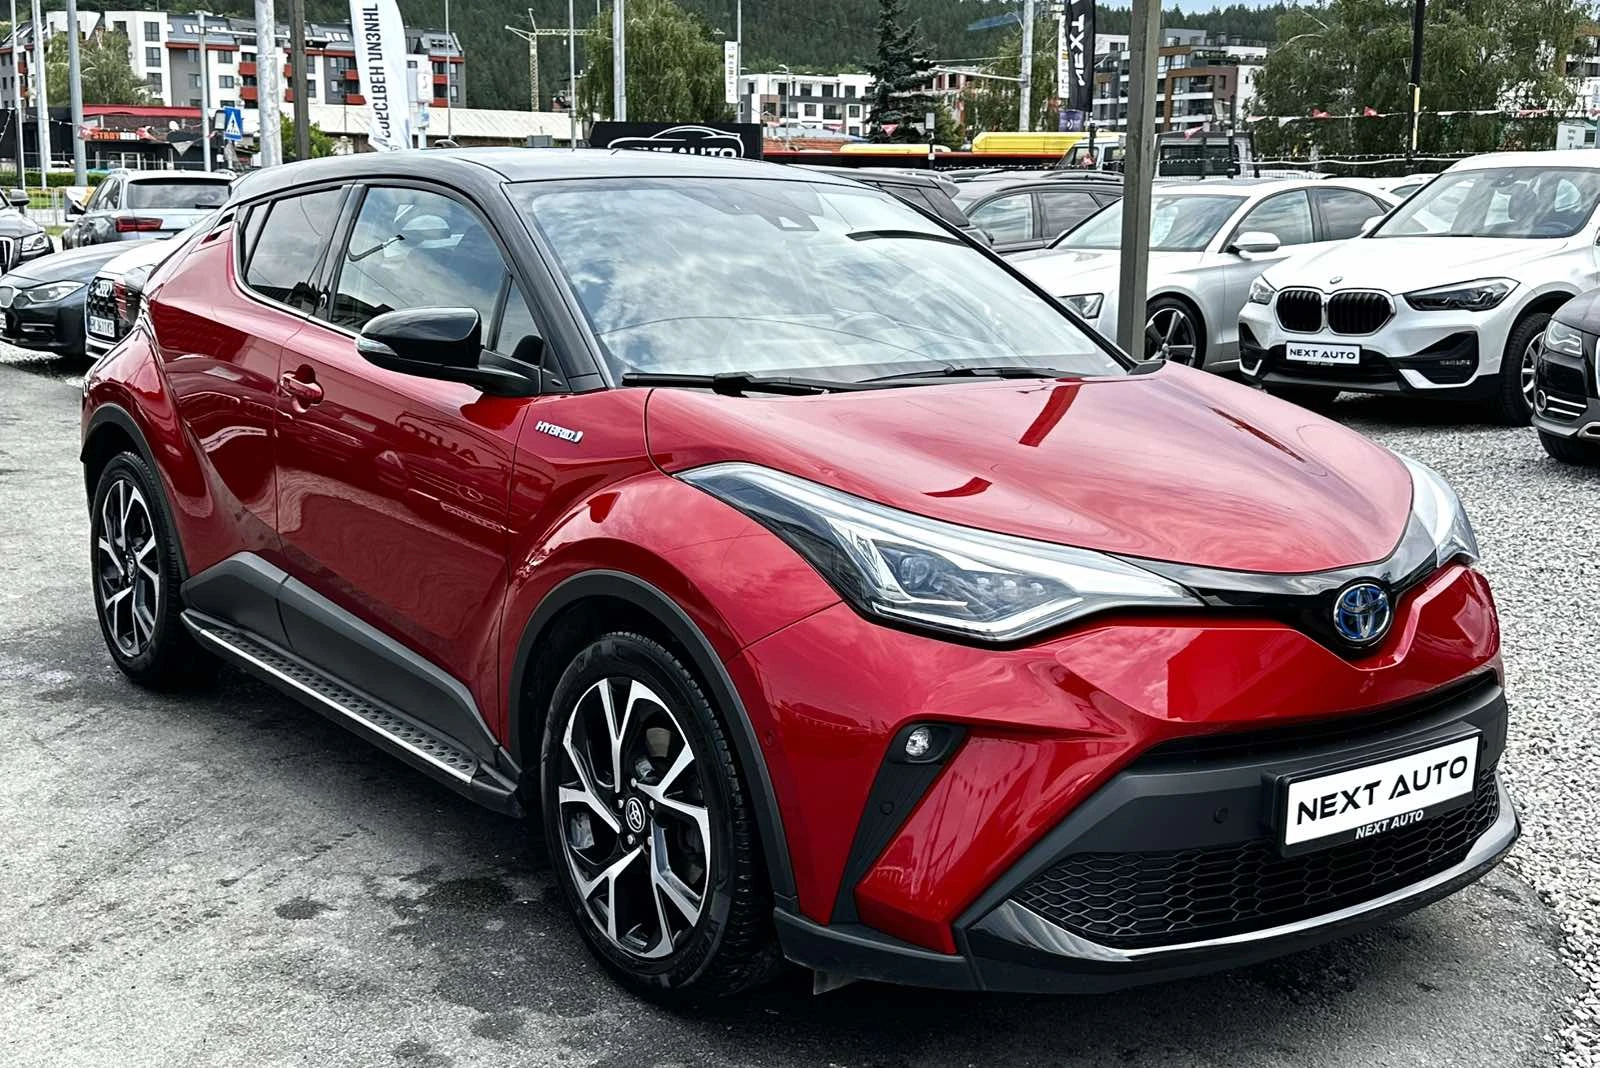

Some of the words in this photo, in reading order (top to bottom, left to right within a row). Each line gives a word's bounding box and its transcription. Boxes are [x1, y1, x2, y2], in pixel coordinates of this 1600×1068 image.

[1289, 348, 1317, 358] NEXT
[1320, 350, 1357, 360] AUTO
[535, 420, 578, 442] HYBRID
[1296, 780, 1382, 826] NEXT
[1388, 755, 1468, 800] AUTO
[1355, 818, 1390, 840] NEXT
[1390, 809, 1424, 830] AUTO
